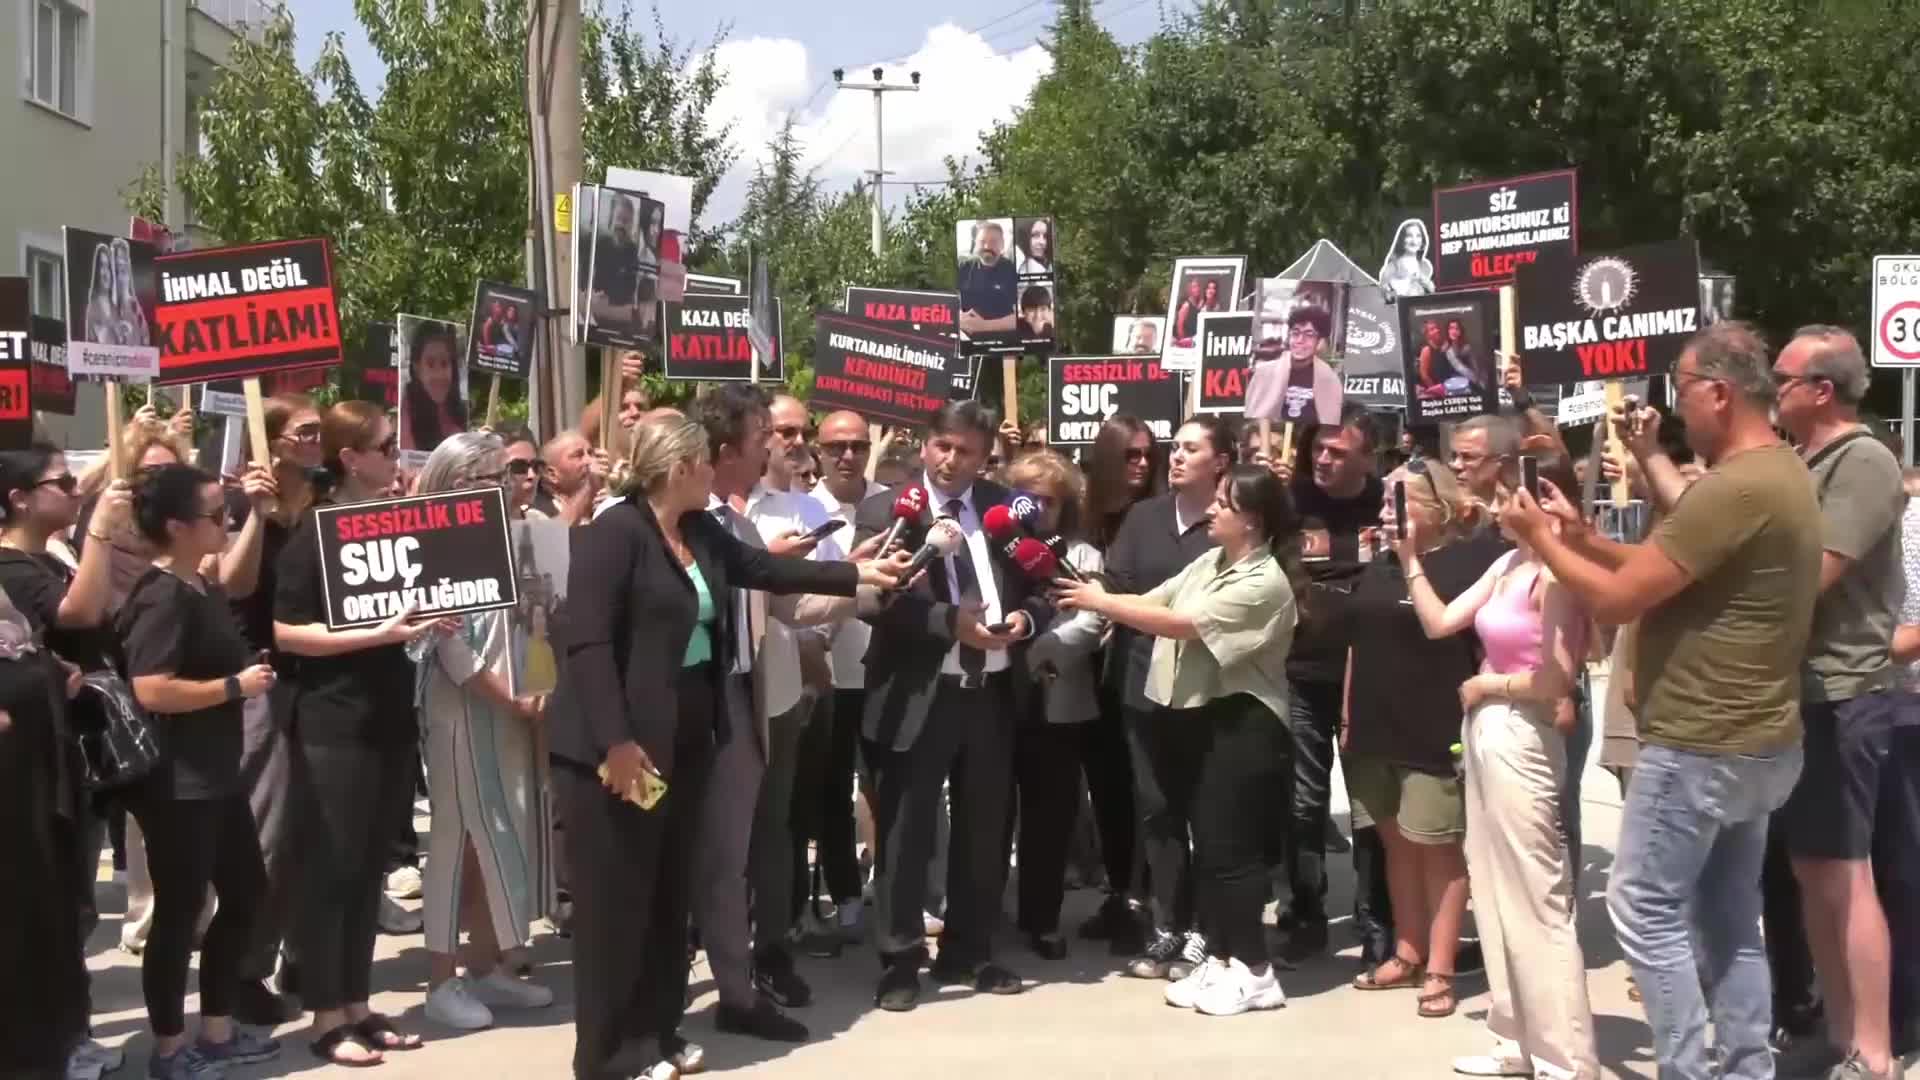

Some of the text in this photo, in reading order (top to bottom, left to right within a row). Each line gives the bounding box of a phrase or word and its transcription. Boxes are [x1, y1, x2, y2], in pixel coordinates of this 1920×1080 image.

[1489, 187, 1517, 213] SİZ
[1440, 202, 1570, 239] SANIYORSUNUZ Kİ
[163, 257, 308, 302] İHMAL DEĞİL
[158, 302, 331, 356] KATLİAM!
[681, 308, 750, 329] KAZA DEĞ
[865, 303, 954, 325] KAZA DEĞİL
[1524, 308, 1696, 351] BAŞKA CANIMIZ
[671, 328, 776, 360] KATLİA
[829, 332, 946, 371] KURTARABİLİRDİNİZ
[1207, 331, 1253, 356] İHM
[1577, 340, 1647, 376] YOK!
[844, 355, 928, 391] KENDİNİZİ
[1063, 359, 1143, 383] SESSİZLİK
[1344, 374, 1380, 394] İZZET
[1061, 383, 1119, 421] SUÇ
[1059, 420, 1172, 440] ORTADIR
[336, 500, 485, 540] SESSİZLİK DE
[340, 536, 423, 588] SUÇ
[343, 577, 501, 621] ORTAKLIĞIDIR
